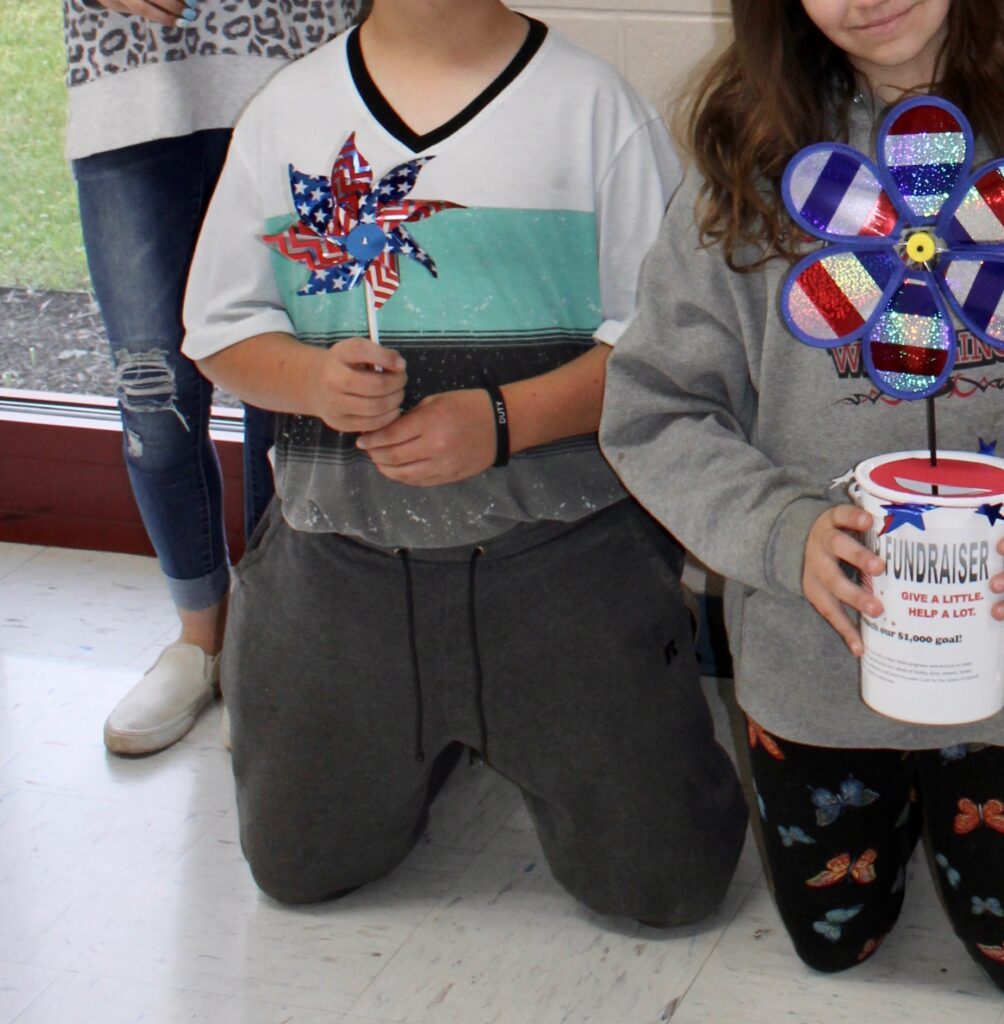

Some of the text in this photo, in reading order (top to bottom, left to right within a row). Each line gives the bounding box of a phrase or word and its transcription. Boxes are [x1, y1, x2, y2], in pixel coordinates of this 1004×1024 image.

[885, 535, 988, 584] FUNDRAISER
[901, 591, 984, 604] GIVE A LITTLE.
[908, 607, 976, 618] HELP A LOT.
[880, 627, 896, 638] our
[897, 632, 933, 644] $1,000
[935, 634, 963, 646] goal!
